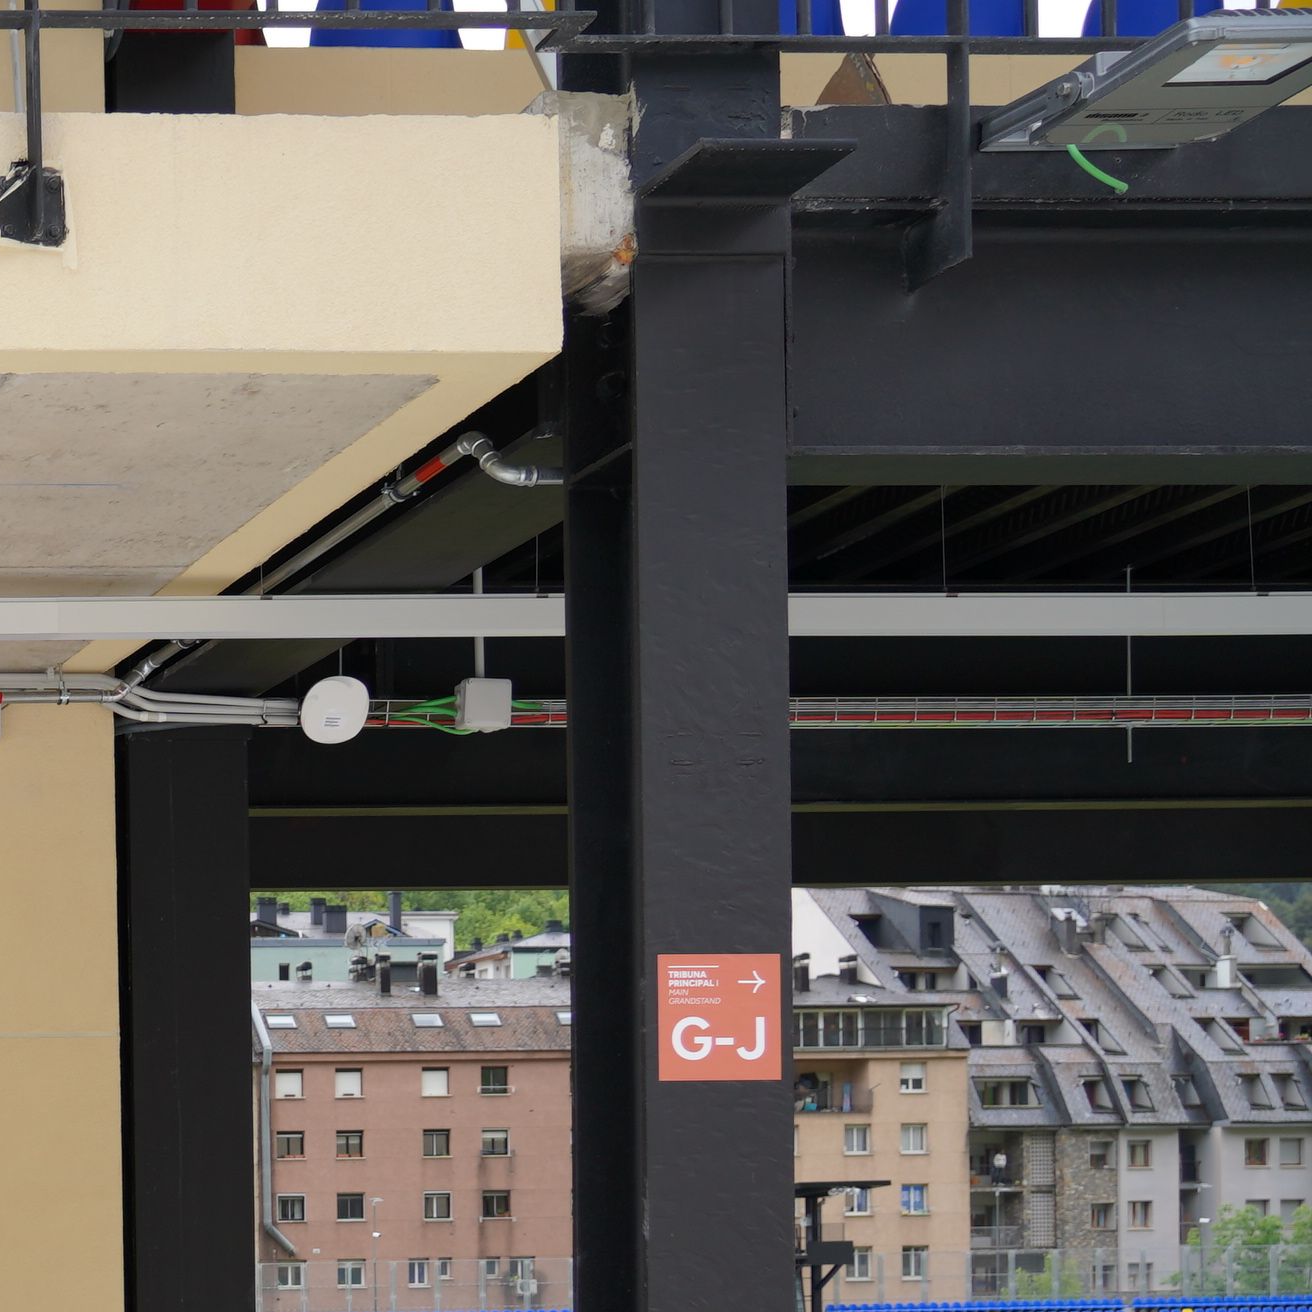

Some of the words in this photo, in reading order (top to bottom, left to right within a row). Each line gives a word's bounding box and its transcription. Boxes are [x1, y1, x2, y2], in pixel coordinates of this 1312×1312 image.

[668, 979, 715, 987] PRINCIPAL
[668, 997, 721, 1005] GRANDSTAND
[671, 1016, 766, 1061] G-J
